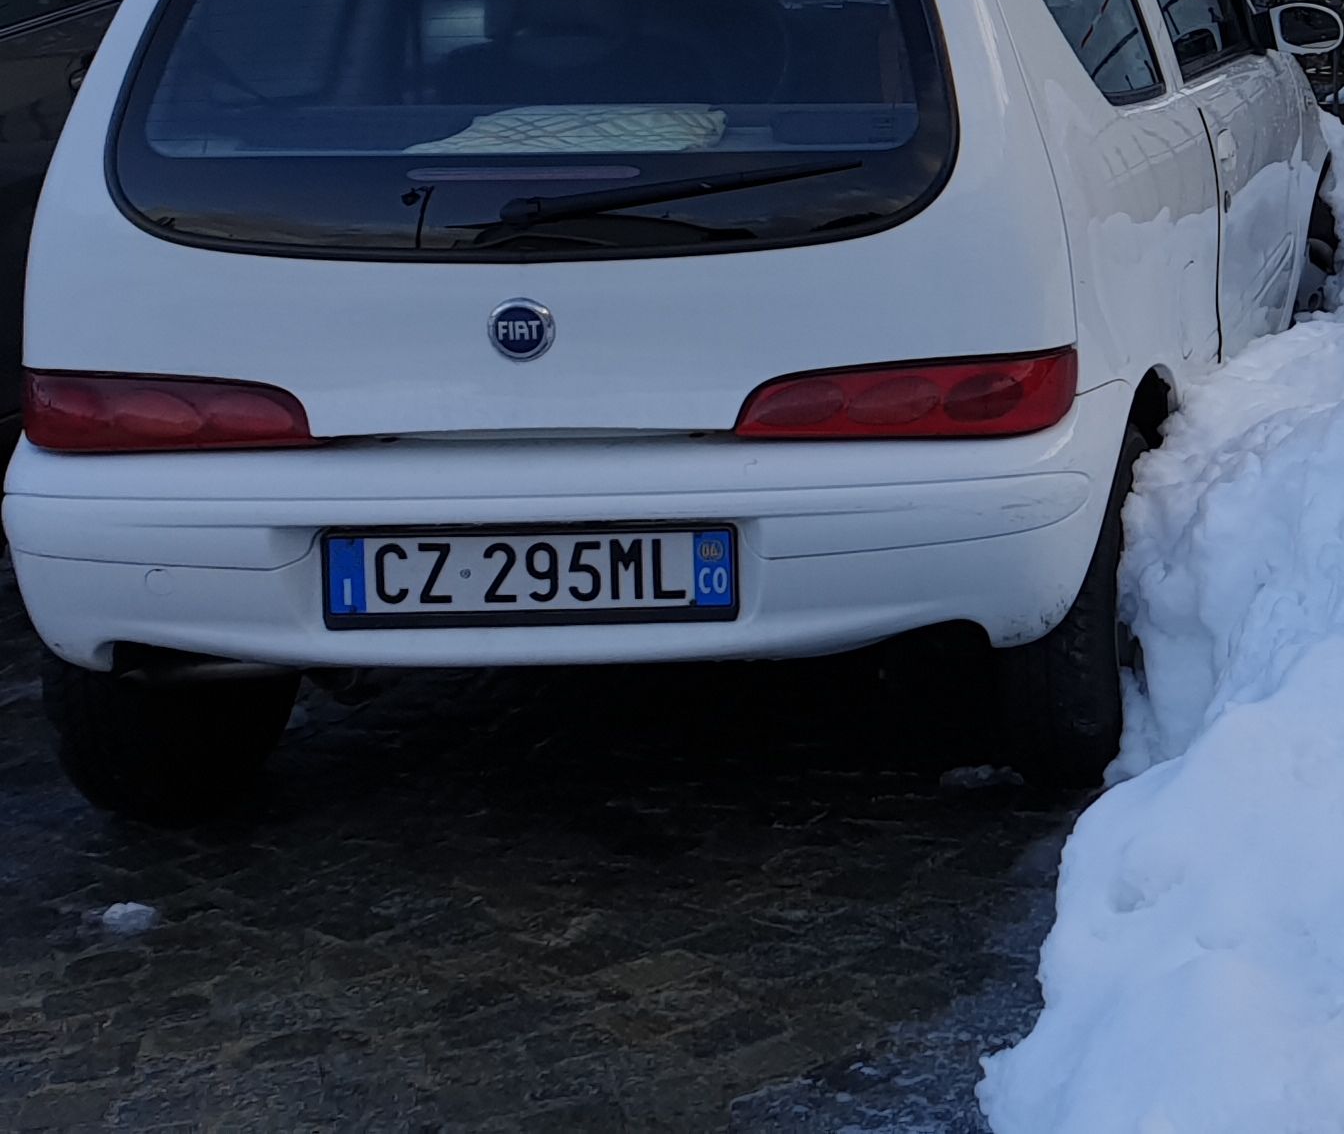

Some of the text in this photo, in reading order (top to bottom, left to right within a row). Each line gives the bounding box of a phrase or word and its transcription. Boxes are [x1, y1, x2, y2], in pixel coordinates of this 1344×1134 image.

[497, 321, 540, 341] FIAT
[342, 538, 687, 606] I CZ 295ML
[698, 567, 728, 594] CO
